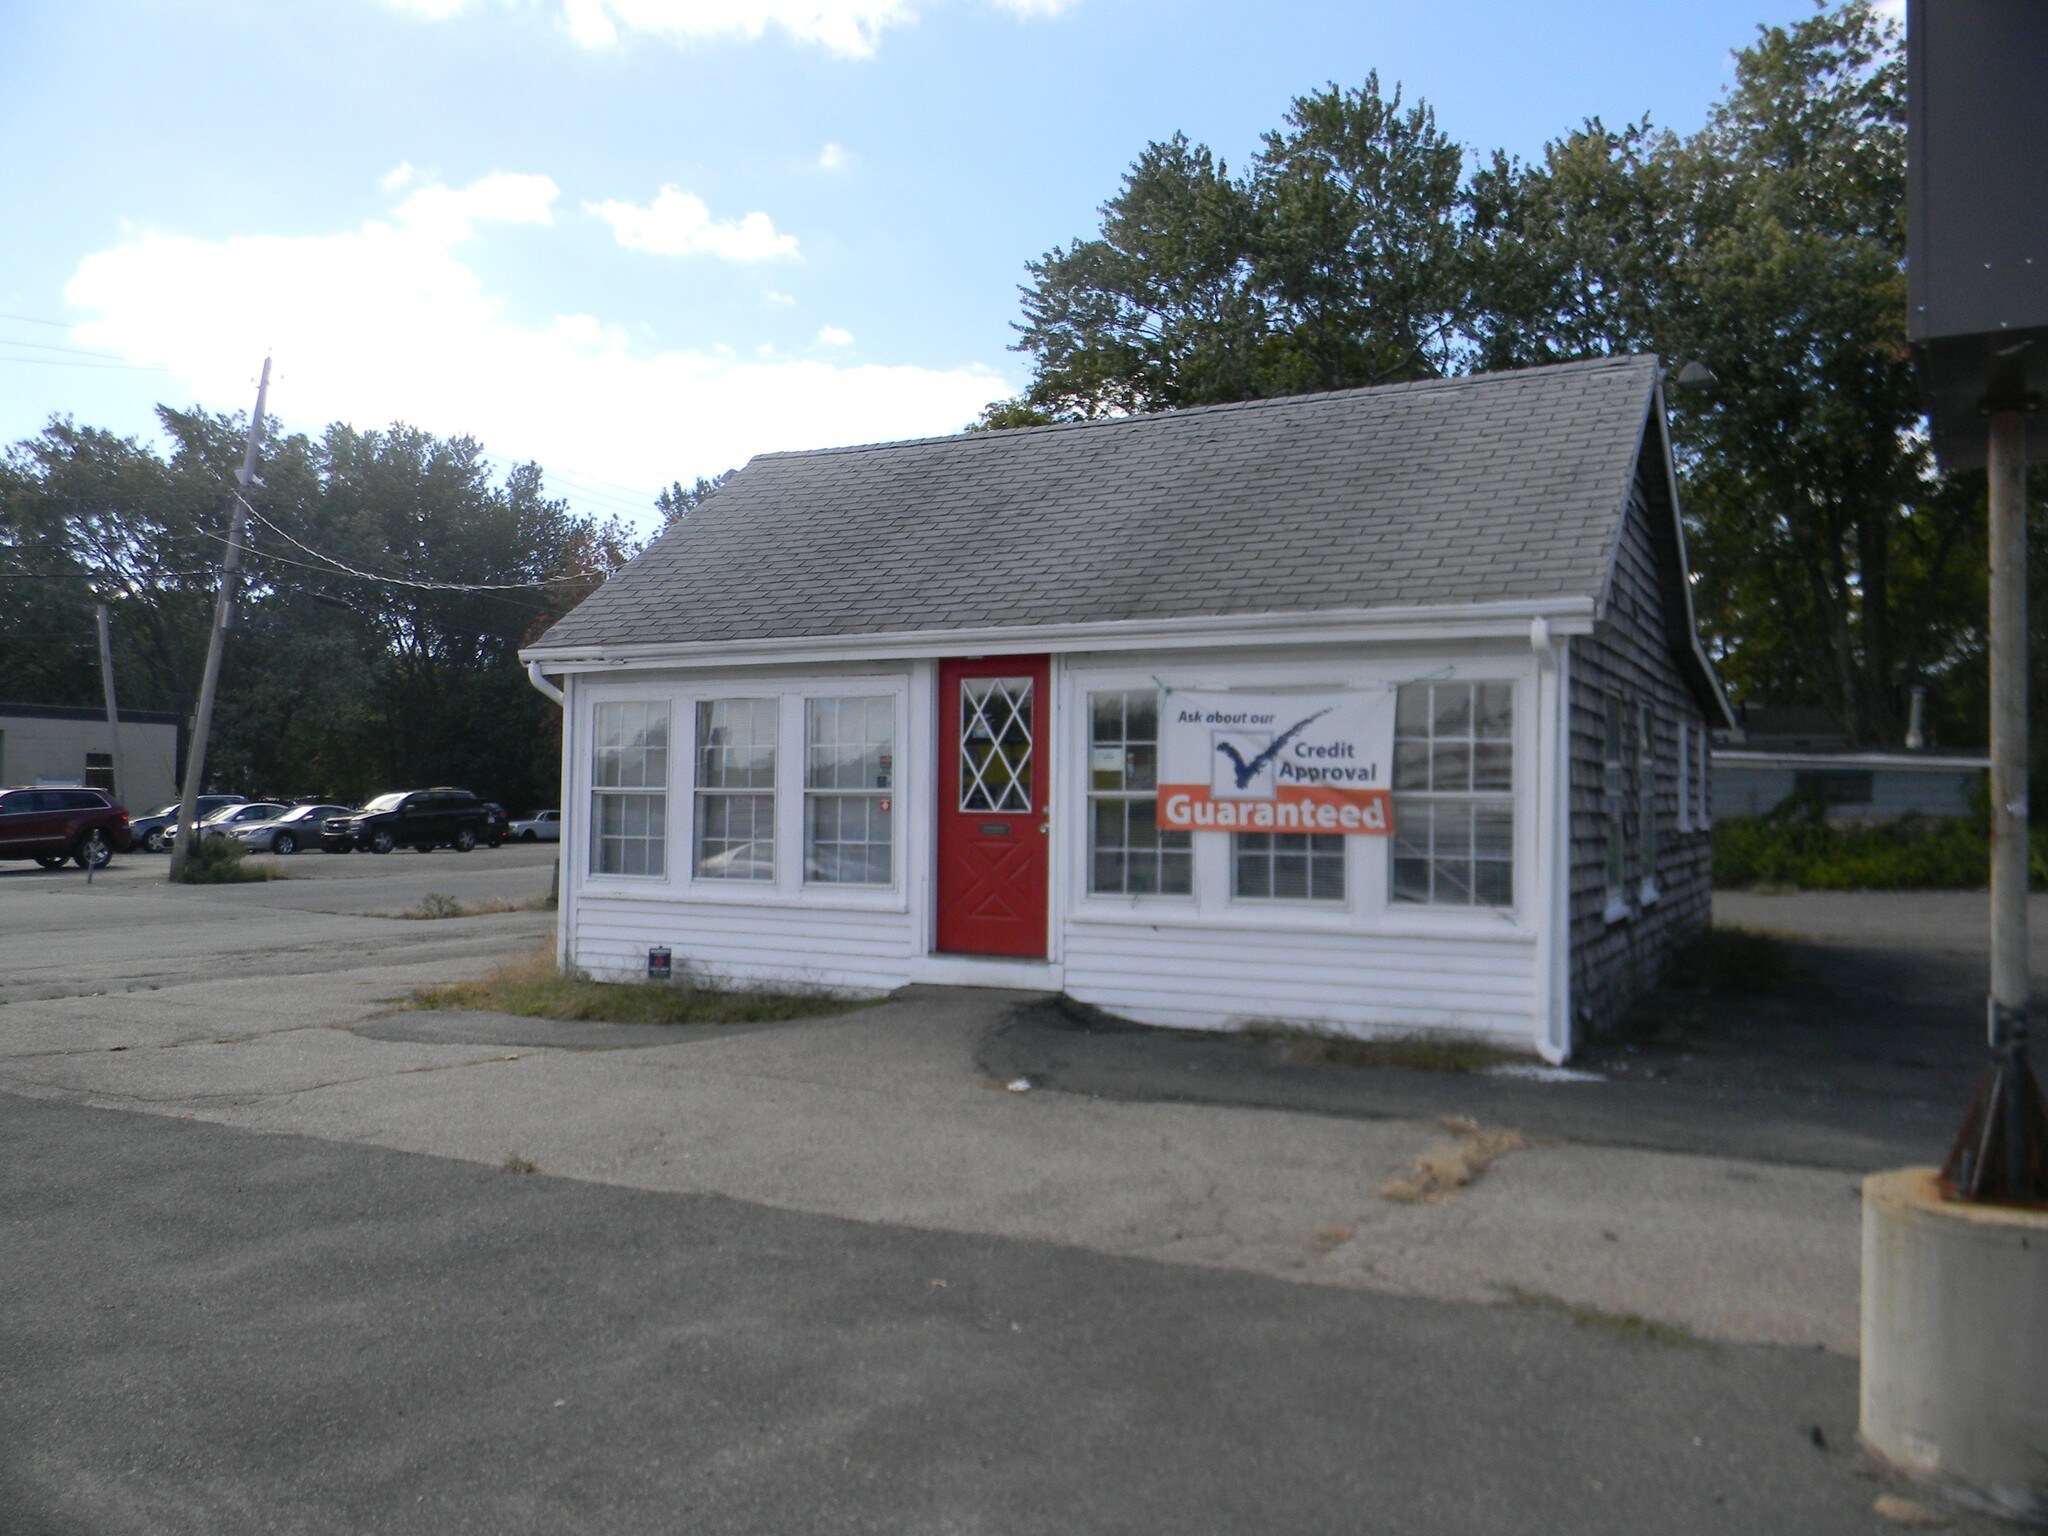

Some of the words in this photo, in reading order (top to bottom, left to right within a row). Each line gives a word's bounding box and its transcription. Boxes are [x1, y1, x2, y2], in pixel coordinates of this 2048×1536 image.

[1178, 711, 1202, 723] Ask
[1206, 711, 1247, 724] about
[1250, 714, 1275, 724] our
[1295, 742, 1354, 758] Credit
[1280, 763, 1376, 782] Approval
[1166, 794, 1386, 829] Guaranteed
